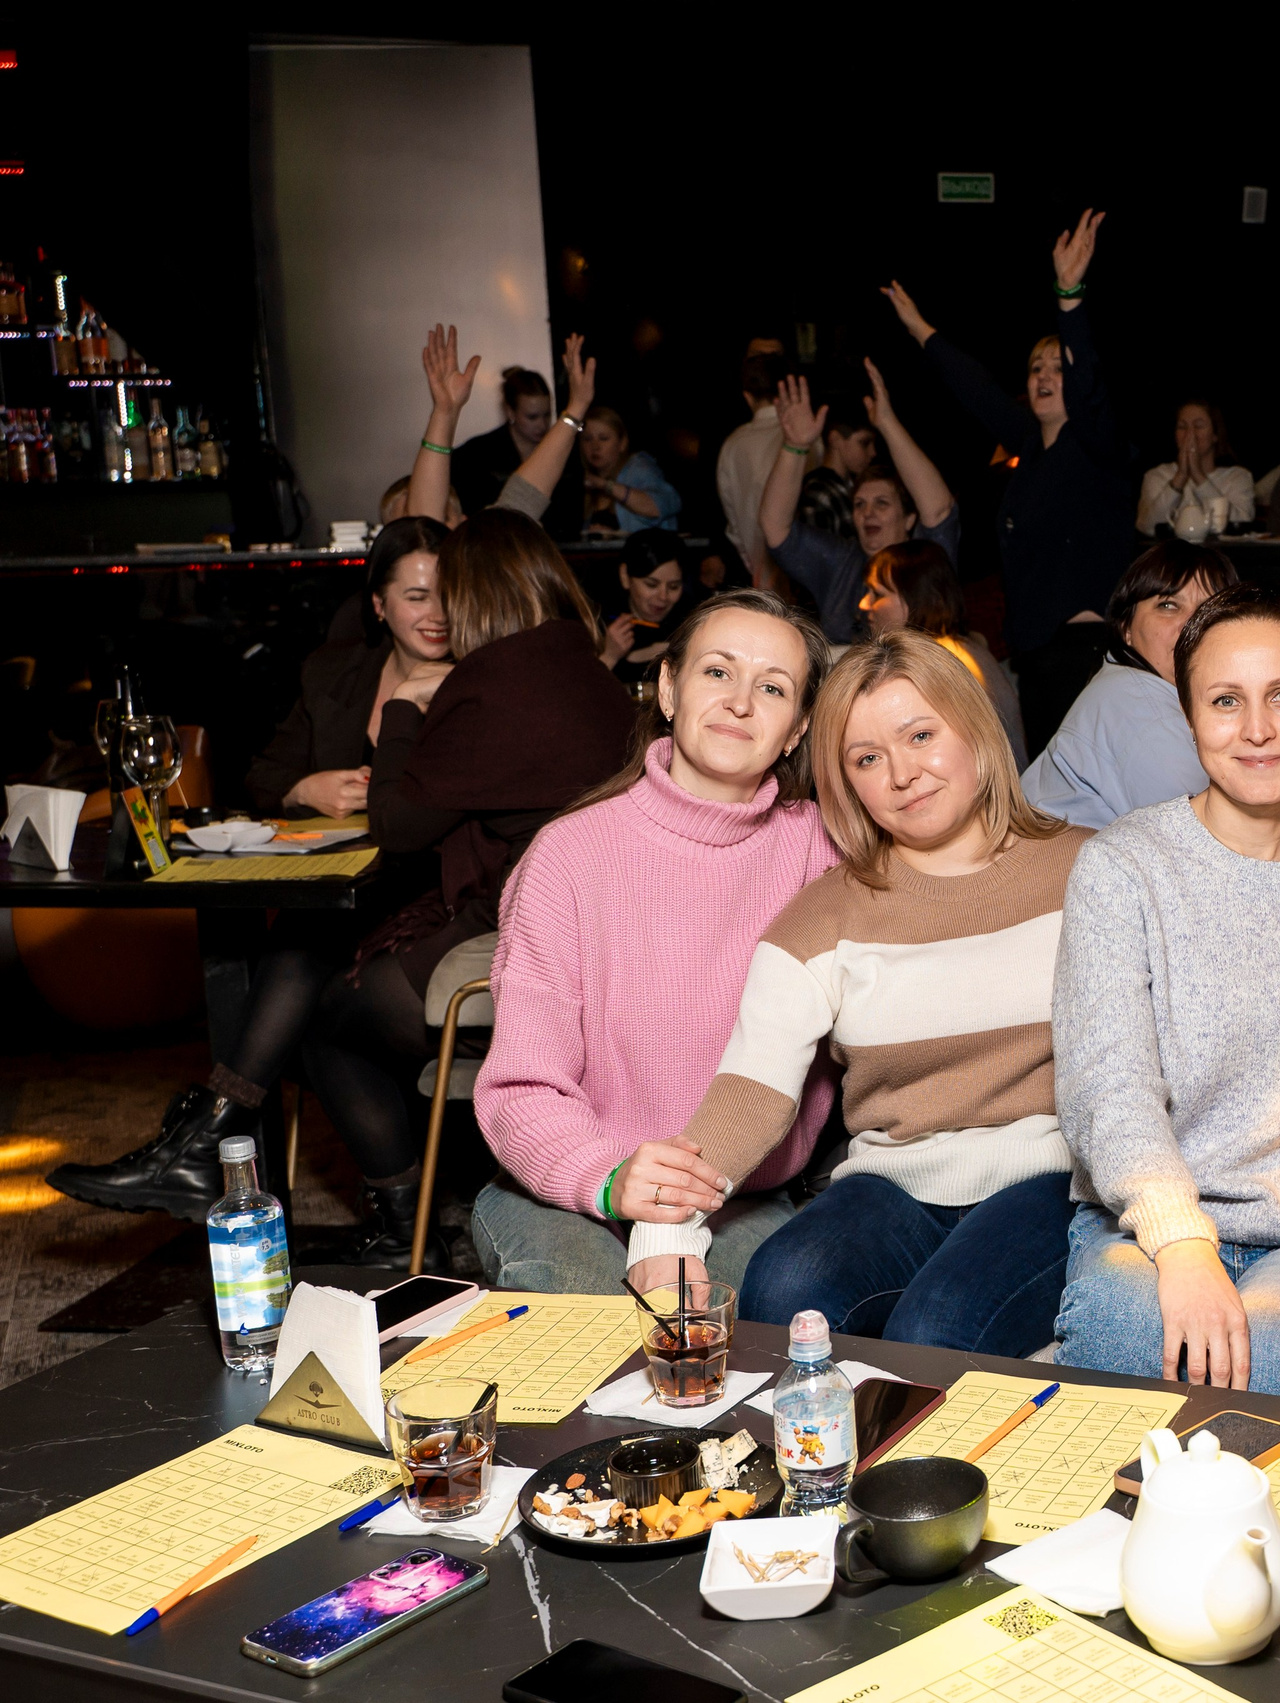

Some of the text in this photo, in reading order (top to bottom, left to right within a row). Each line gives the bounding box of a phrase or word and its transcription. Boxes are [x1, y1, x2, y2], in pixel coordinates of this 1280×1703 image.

[512, 1405, 562, 1414] MIXLOTO
[297, 1408, 341, 1427] ASTRO CLUB
[224, 1439, 264, 1454] MIXLOTO
[1015, 1522, 1060, 1531] IXLOTO
